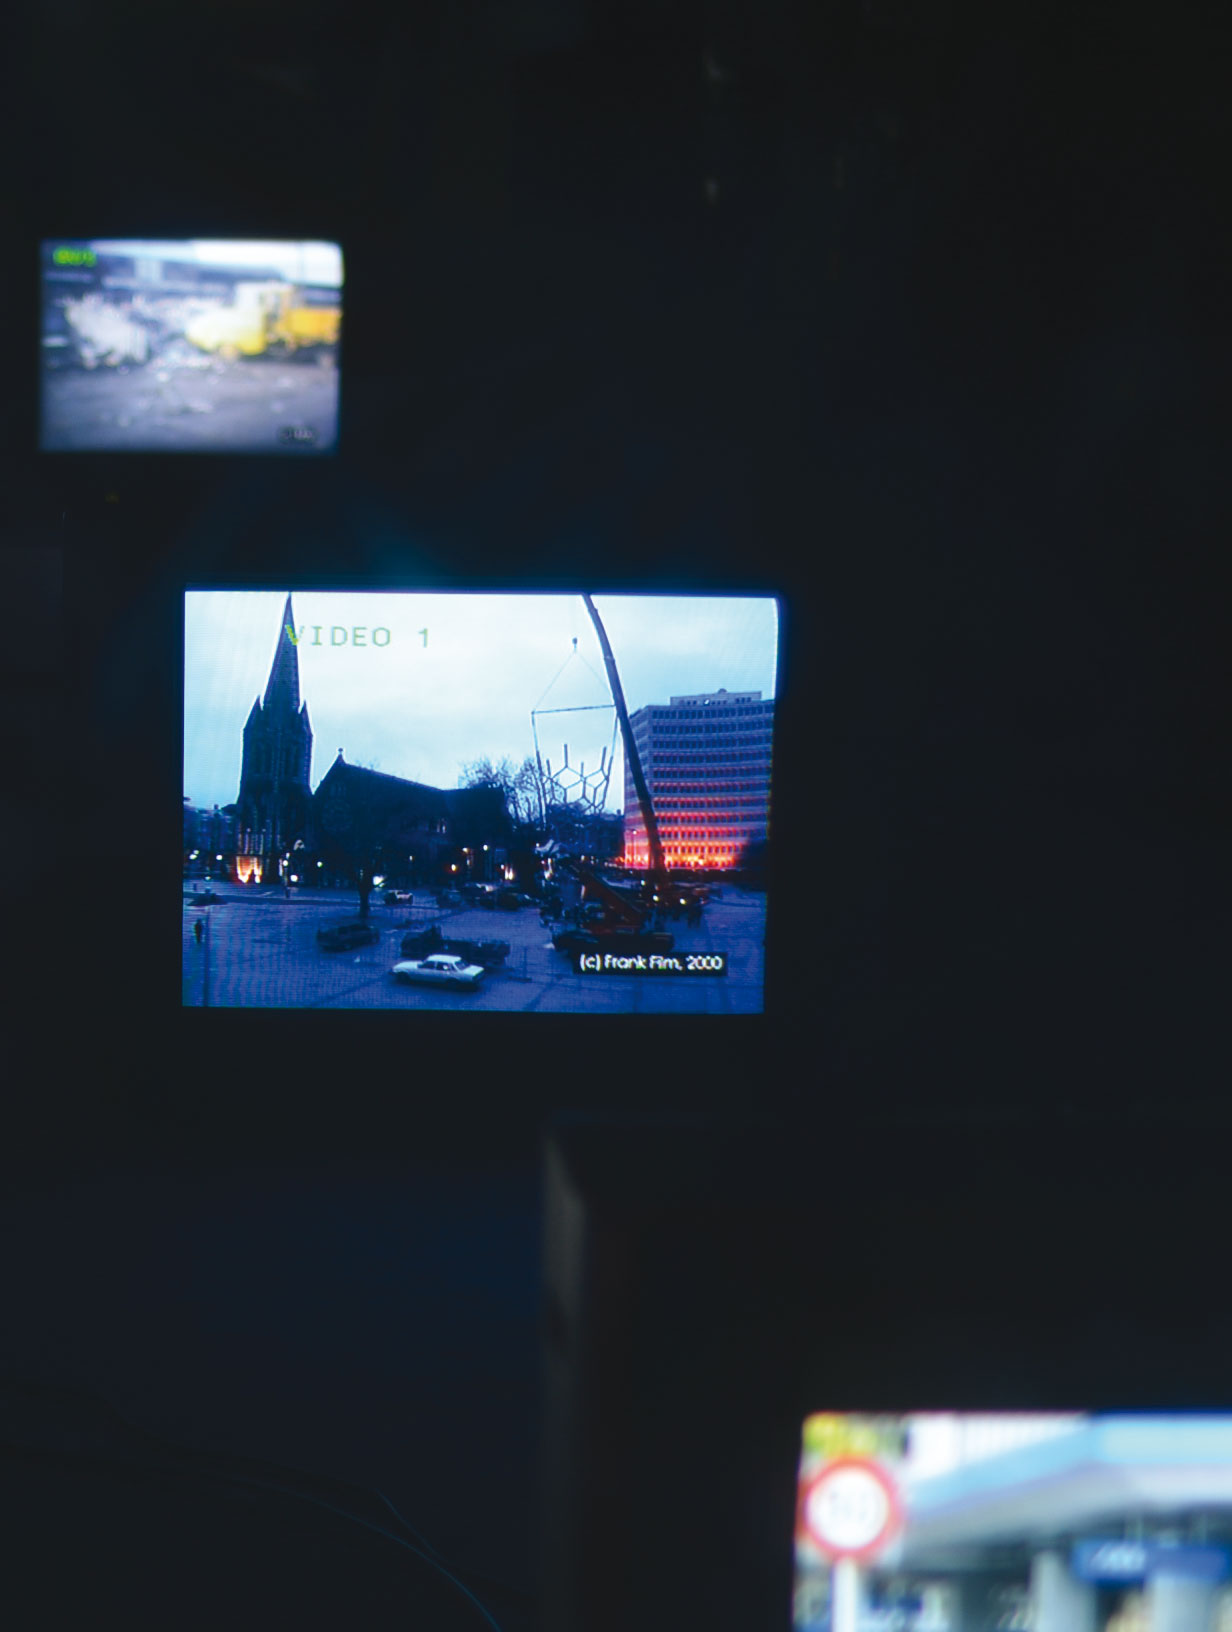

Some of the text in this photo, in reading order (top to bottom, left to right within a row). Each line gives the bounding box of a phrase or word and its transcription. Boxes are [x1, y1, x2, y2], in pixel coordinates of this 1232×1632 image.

[284, 624, 429, 648] VIDEO 1
[579, 953, 601, 971] (c)
[604, 954, 647, 969] Frank
[685, 955, 723, 970] 2000
